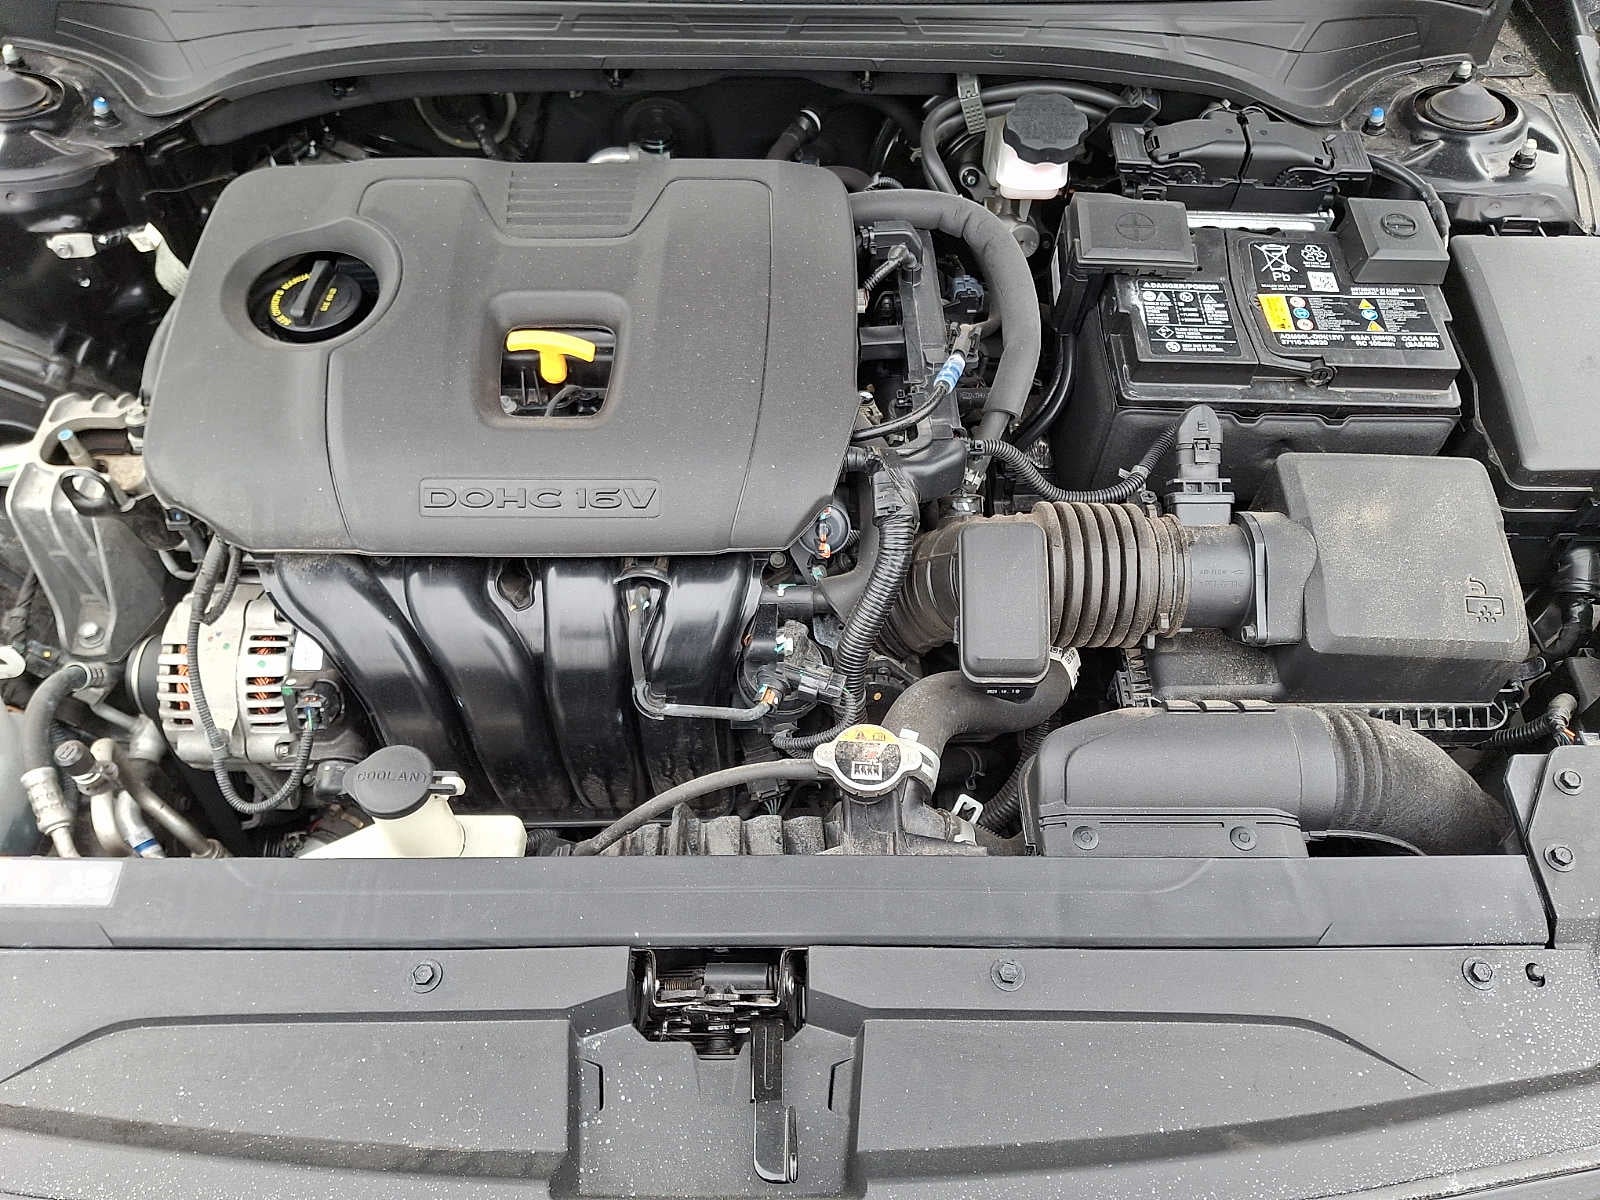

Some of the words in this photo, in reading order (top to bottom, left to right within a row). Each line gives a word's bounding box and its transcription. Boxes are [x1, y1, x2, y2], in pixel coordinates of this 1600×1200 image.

[1272, 271, 1291, 281] Pb
[423, 487, 562, 509] DOHC
[576, 487, 657, 509] 16V
[357, 767, 428, 784] COOLANT
